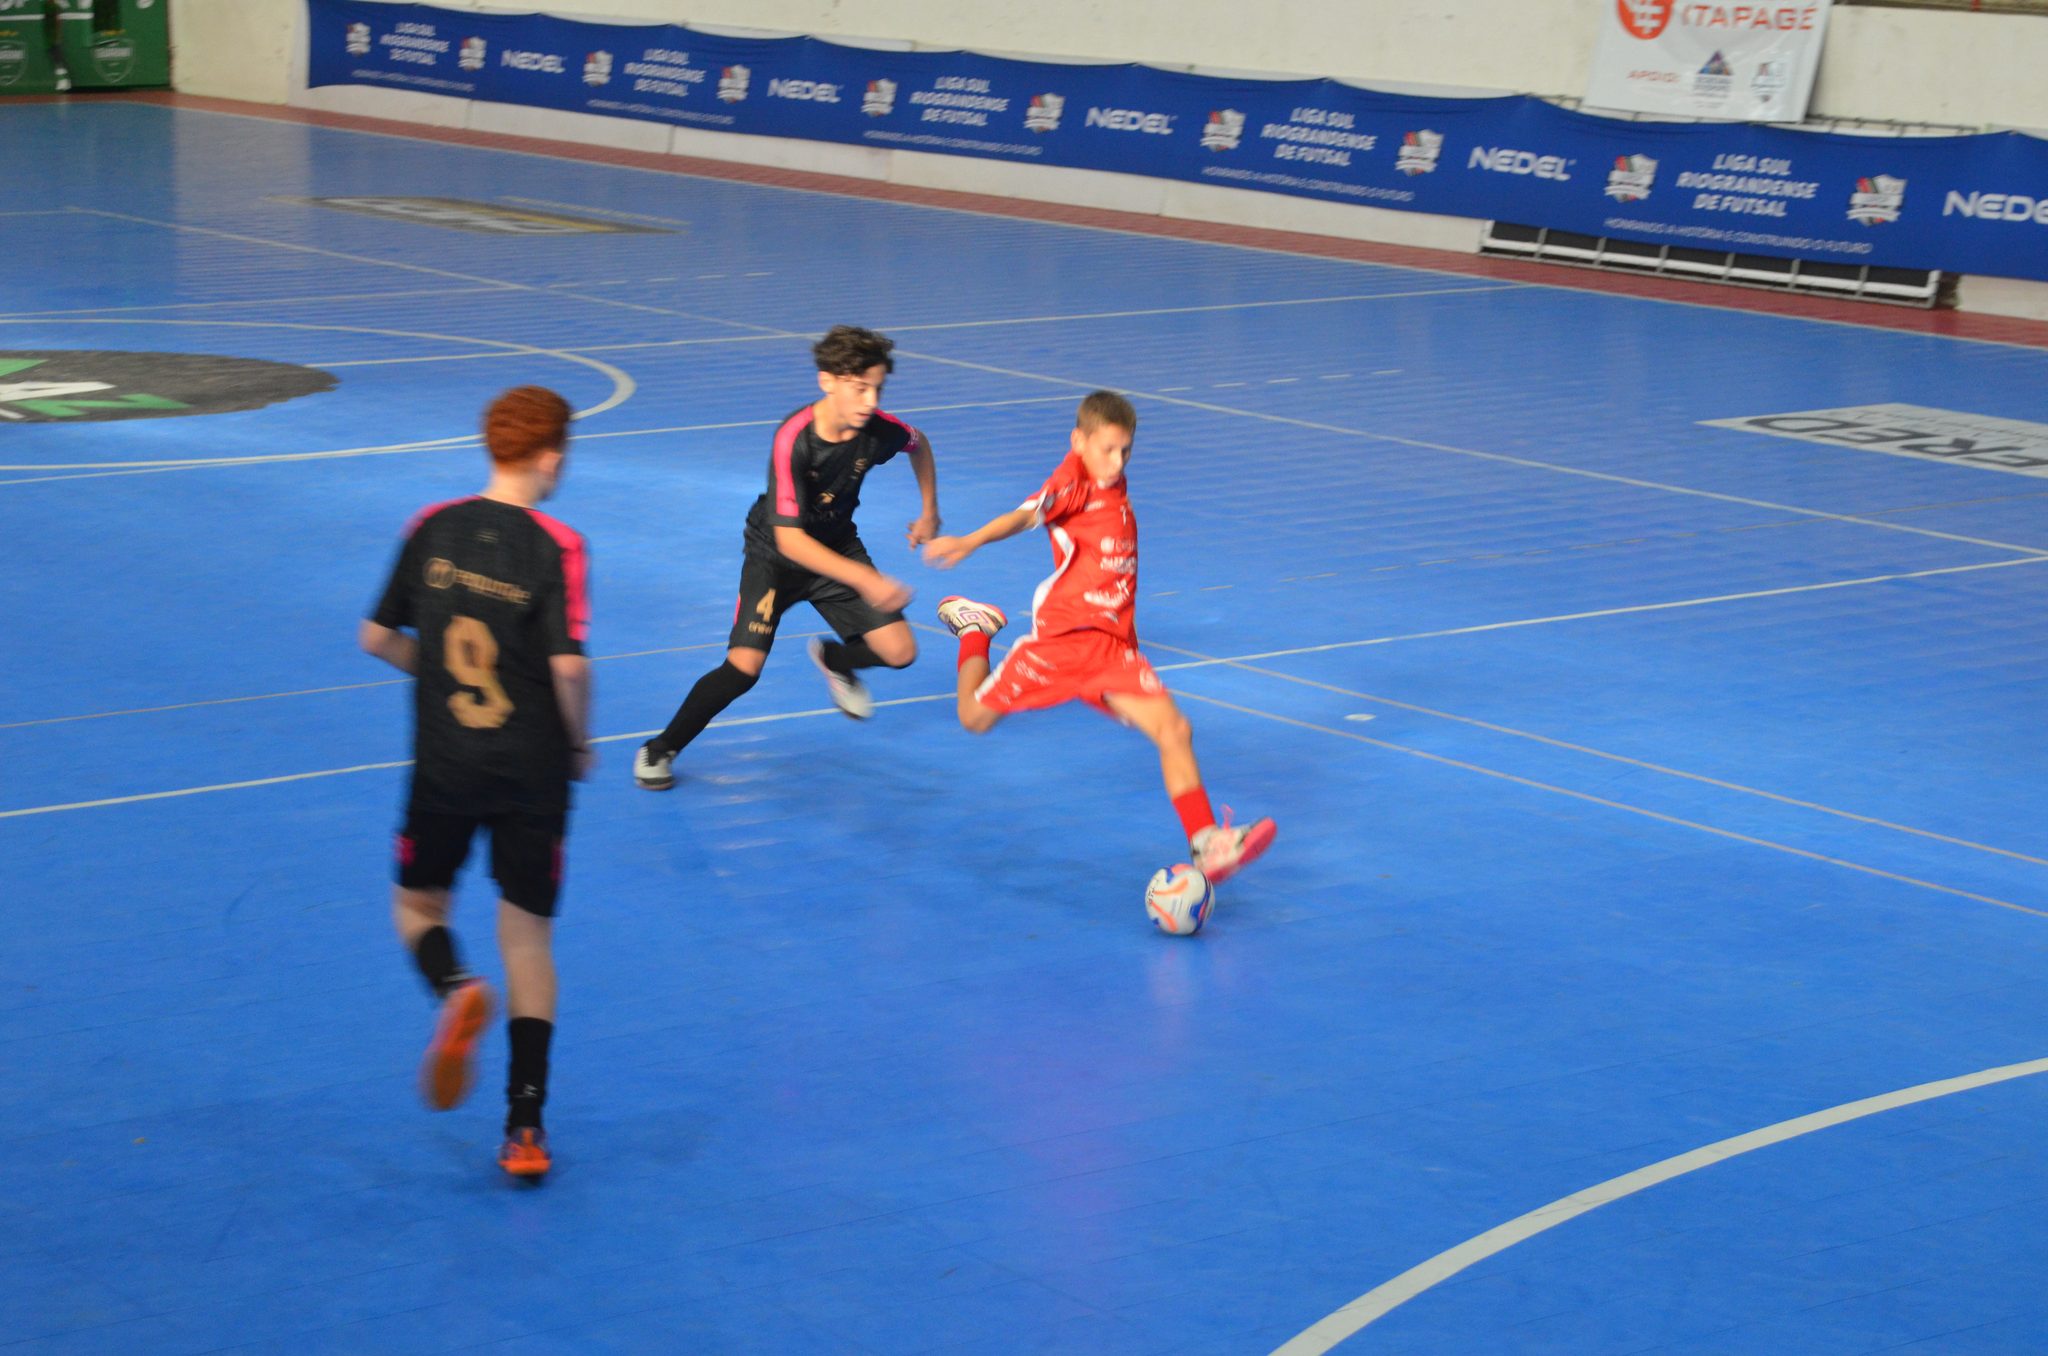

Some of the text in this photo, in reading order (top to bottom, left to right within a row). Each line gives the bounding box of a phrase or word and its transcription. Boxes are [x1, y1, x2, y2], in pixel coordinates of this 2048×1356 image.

[767, 78, 841, 103] NEDEL
[1085, 106, 1174, 135] NEDEL
[1290, 107, 1355, 129] LIGA SUL
[1260, 123, 1378, 151] RIOGRANDENSE
[1273, 144, 1351, 167] DE FUTSAL
[1467, 145, 1571, 181] NEDEL
[1712, 153, 1792, 176] LIGA SUL
[1676, 171, 1819, 199] RIOGRANDENSE
[1692, 193, 1787, 217] DE FUTSAL
[756, 588, 776, 622] 4
[444, 615, 516, 729] 9
